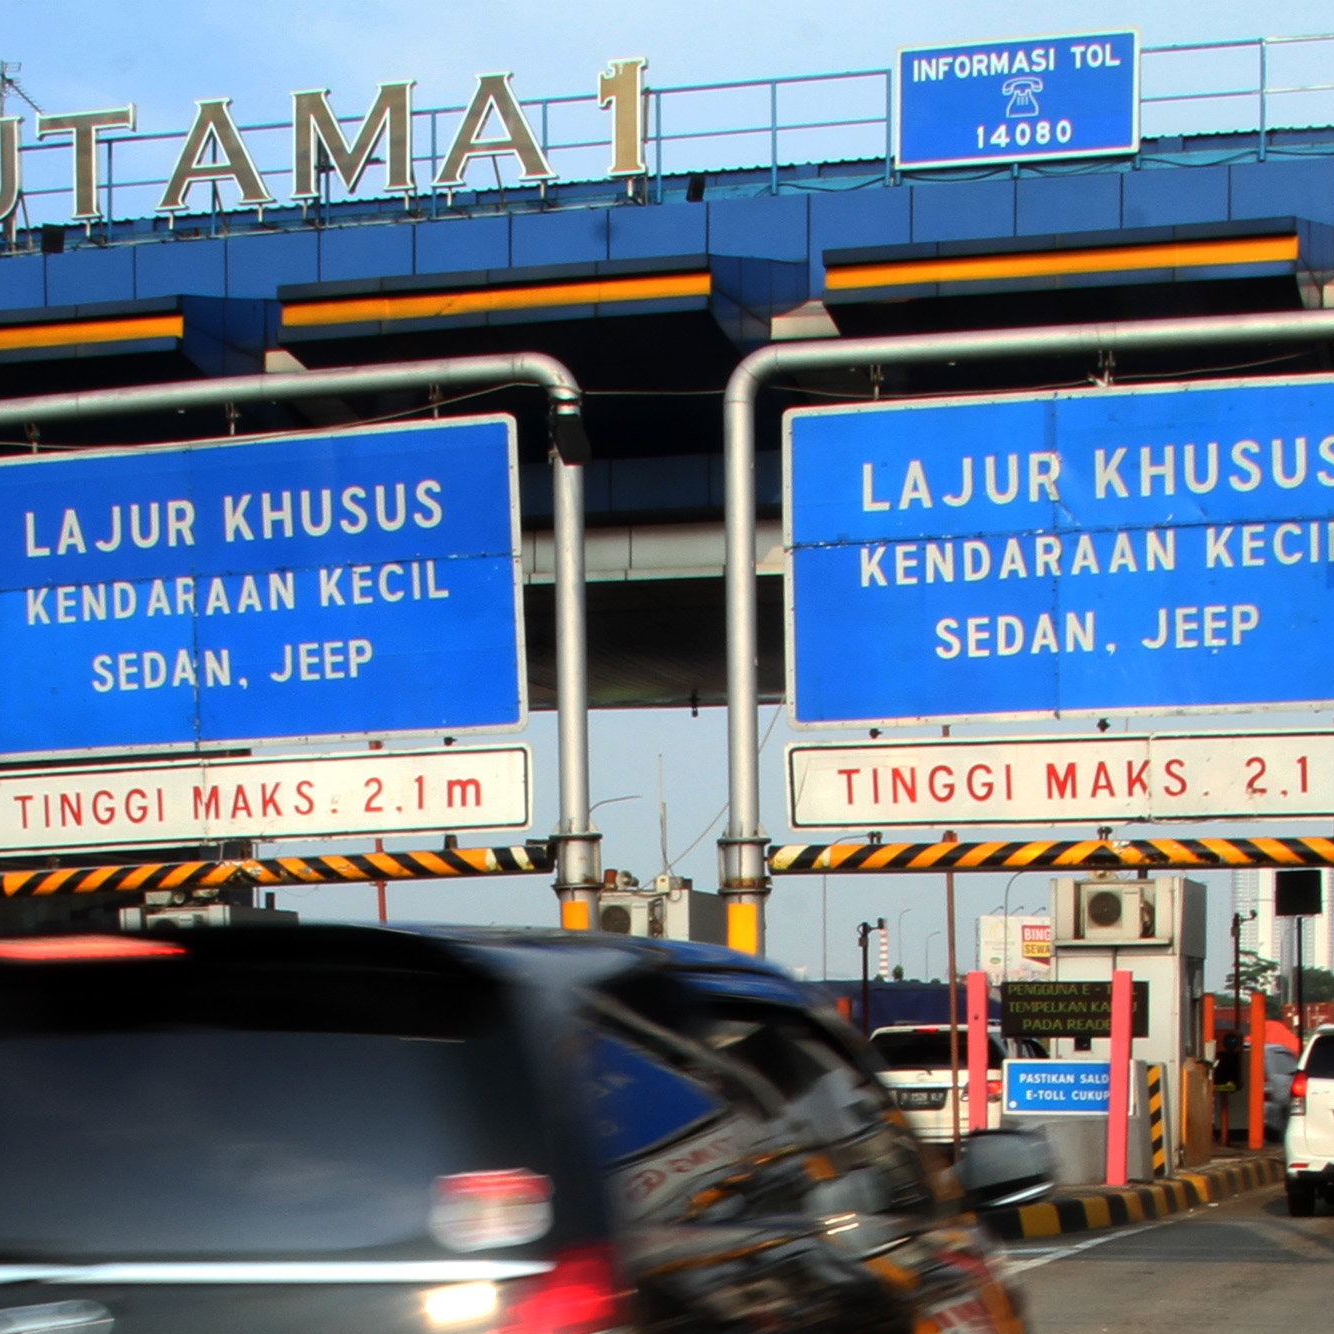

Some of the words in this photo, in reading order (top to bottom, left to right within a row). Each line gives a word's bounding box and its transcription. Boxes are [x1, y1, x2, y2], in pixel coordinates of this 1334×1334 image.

[913, 46, 1056, 82] INFORMASI
[1070, 42, 1121, 68] TOL
[597, 56, 647, 177] 1
[977, 118, 1072, 149] 14080
[863, 451, 1062, 511] LAJUR
[25, 499, 195, 557] LAJUR
[224, 479, 442, 542] KHUSUS
[860, 529, 1175, 587] KENDARAAN
[26, 571, 295, 625] KENDARAAN
[319, 560, 449, 606] KECIL
[935, 611, 1116, 659] SEDAN,
[1142, 604, 1259, 649] JEEP
[92, 648, 247, 692] SEDAN,
[270, 638, 373, 682] JEEP
[14, 788, 165, 829] TINGGI
[193, 780, 338, 820] MAKS.
[837, 764, 1013, 806] TINGGI
[1045, 759, 1211, 800] MAKS.
[1008, 984, 1078, 995] PENGGUNA
[1009, 1002, 1087, 1013] TEMPELKAN
[1022, 1019, 1063, 1031] PADA
[1019, 1073, 1075, 1084] PASTIKAN
[1080, 1073, 1110, 1084] SALD
[1026, 1090, 1066, 1101] E-TOLL
